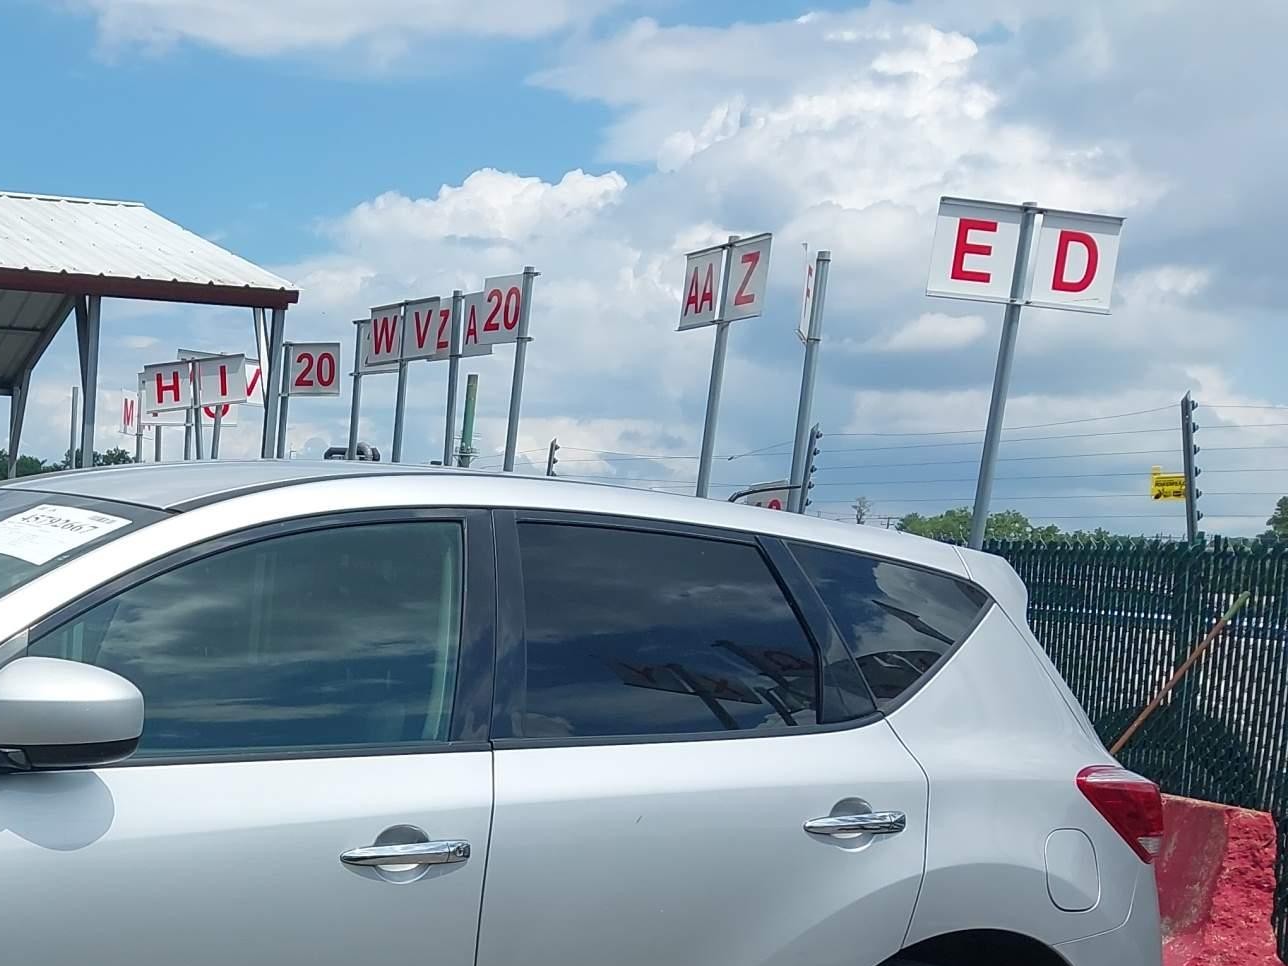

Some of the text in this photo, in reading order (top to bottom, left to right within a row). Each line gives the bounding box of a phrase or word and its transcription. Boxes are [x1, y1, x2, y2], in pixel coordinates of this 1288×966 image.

[950, 217, 998, 284] E
[1051, 230, 1099, 293] D
[684, 265, 714, 315] AA
[734, 250, 761, 305] Z
[414, 309, 433, 349] V
[465, 305, 478, 345] A
[483, 286, 521, 332] 20
[373, 315, 398, 355] W
[436, 309, 451, 350] Z
[156, 371, 181, 404] H
[219, 365, 228, 397] I
[294, 352, 336, 387] 20
[123, 398, 134, 427] M
